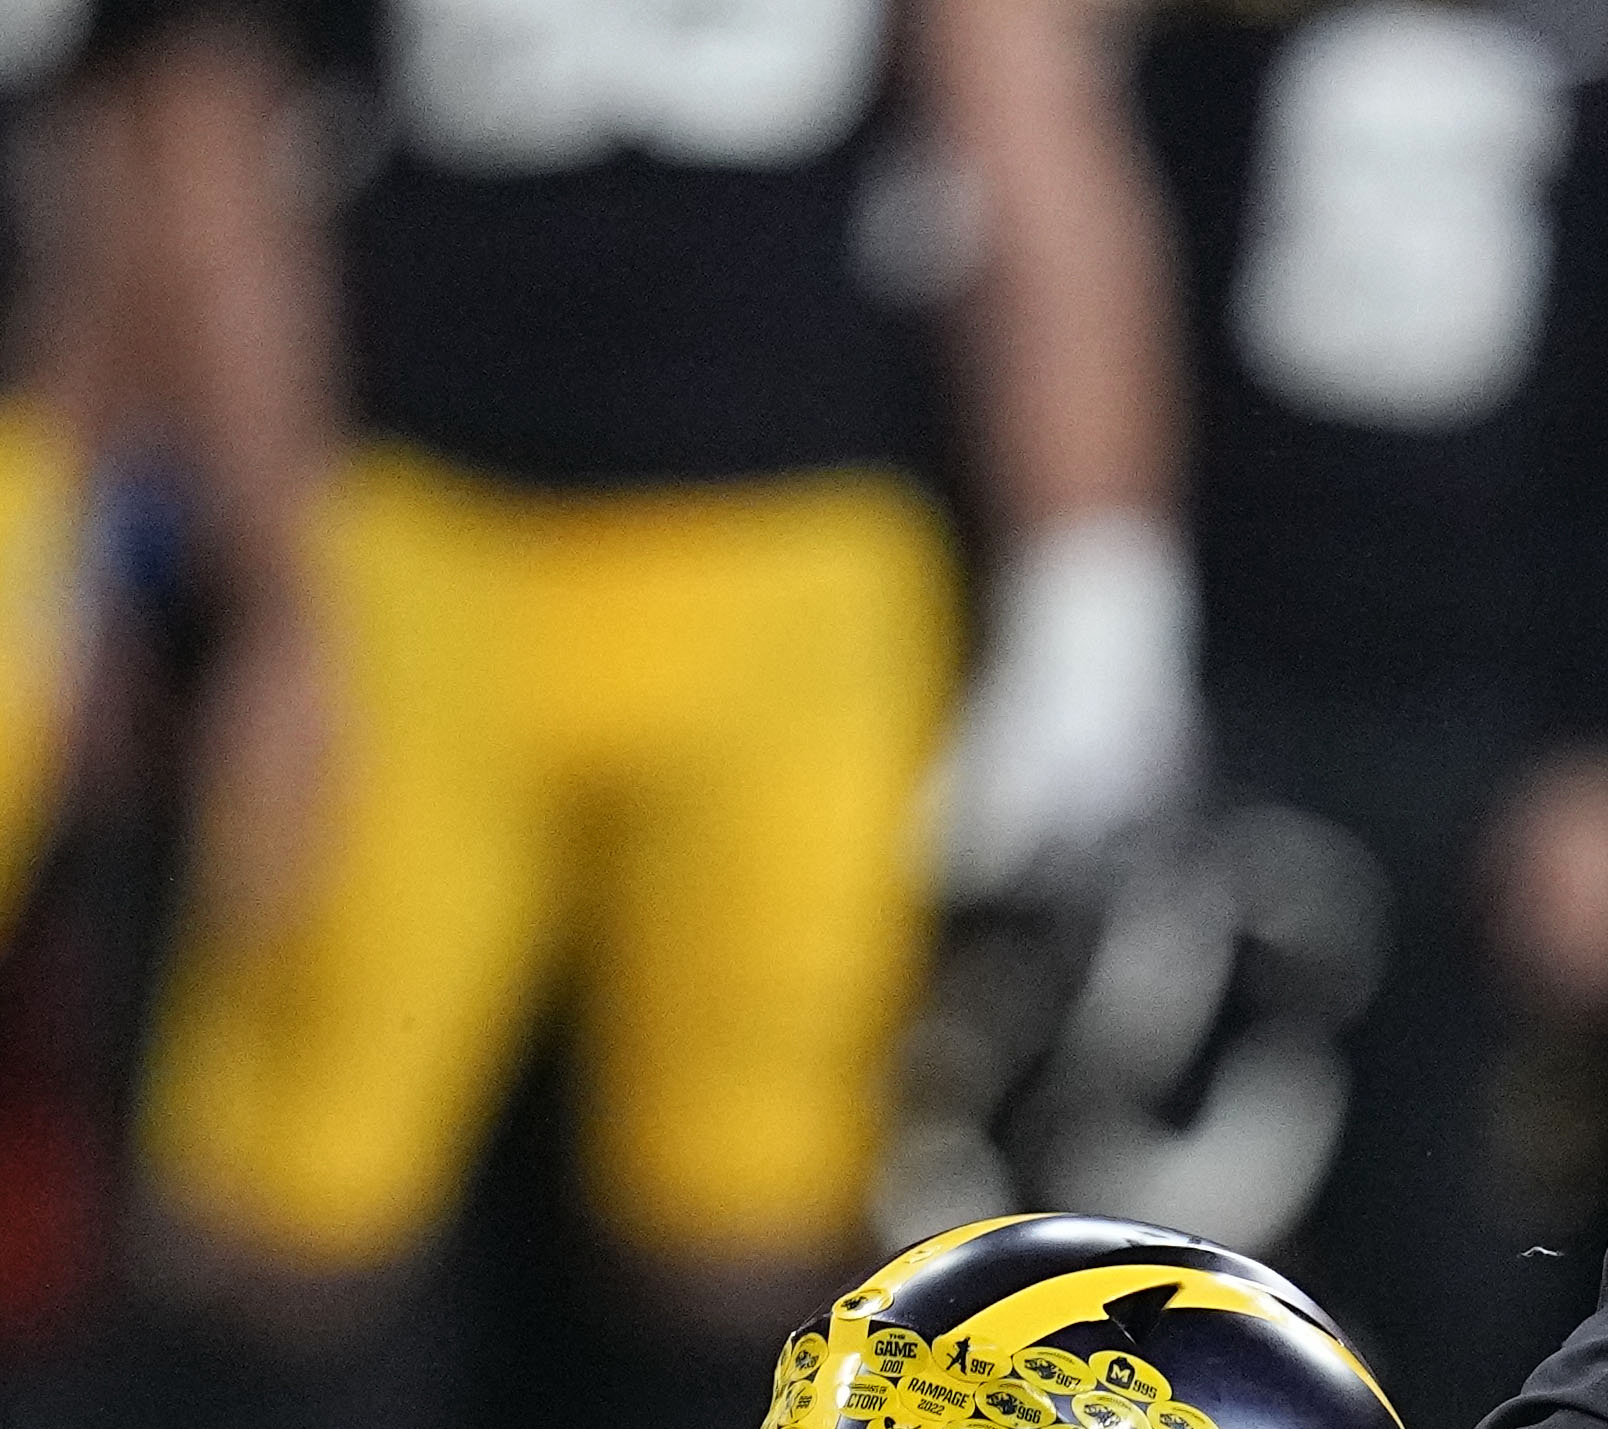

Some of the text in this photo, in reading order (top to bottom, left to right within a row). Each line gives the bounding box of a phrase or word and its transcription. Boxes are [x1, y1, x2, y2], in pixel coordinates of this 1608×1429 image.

[874, 1341, 918, 1359] GAME
[880, 1359, 904, 1374] 1001
[969, 1358, 995, 1377] 997
[907, 1377, 970, 1409] RAMPAGE
[1132, 1380, 1158, 1399] 995
[846, 1393, 888, 1413] CTORY
[917, 1398, 945, 1416] 2022
[1016, 1405, 1042, 1424] 966
